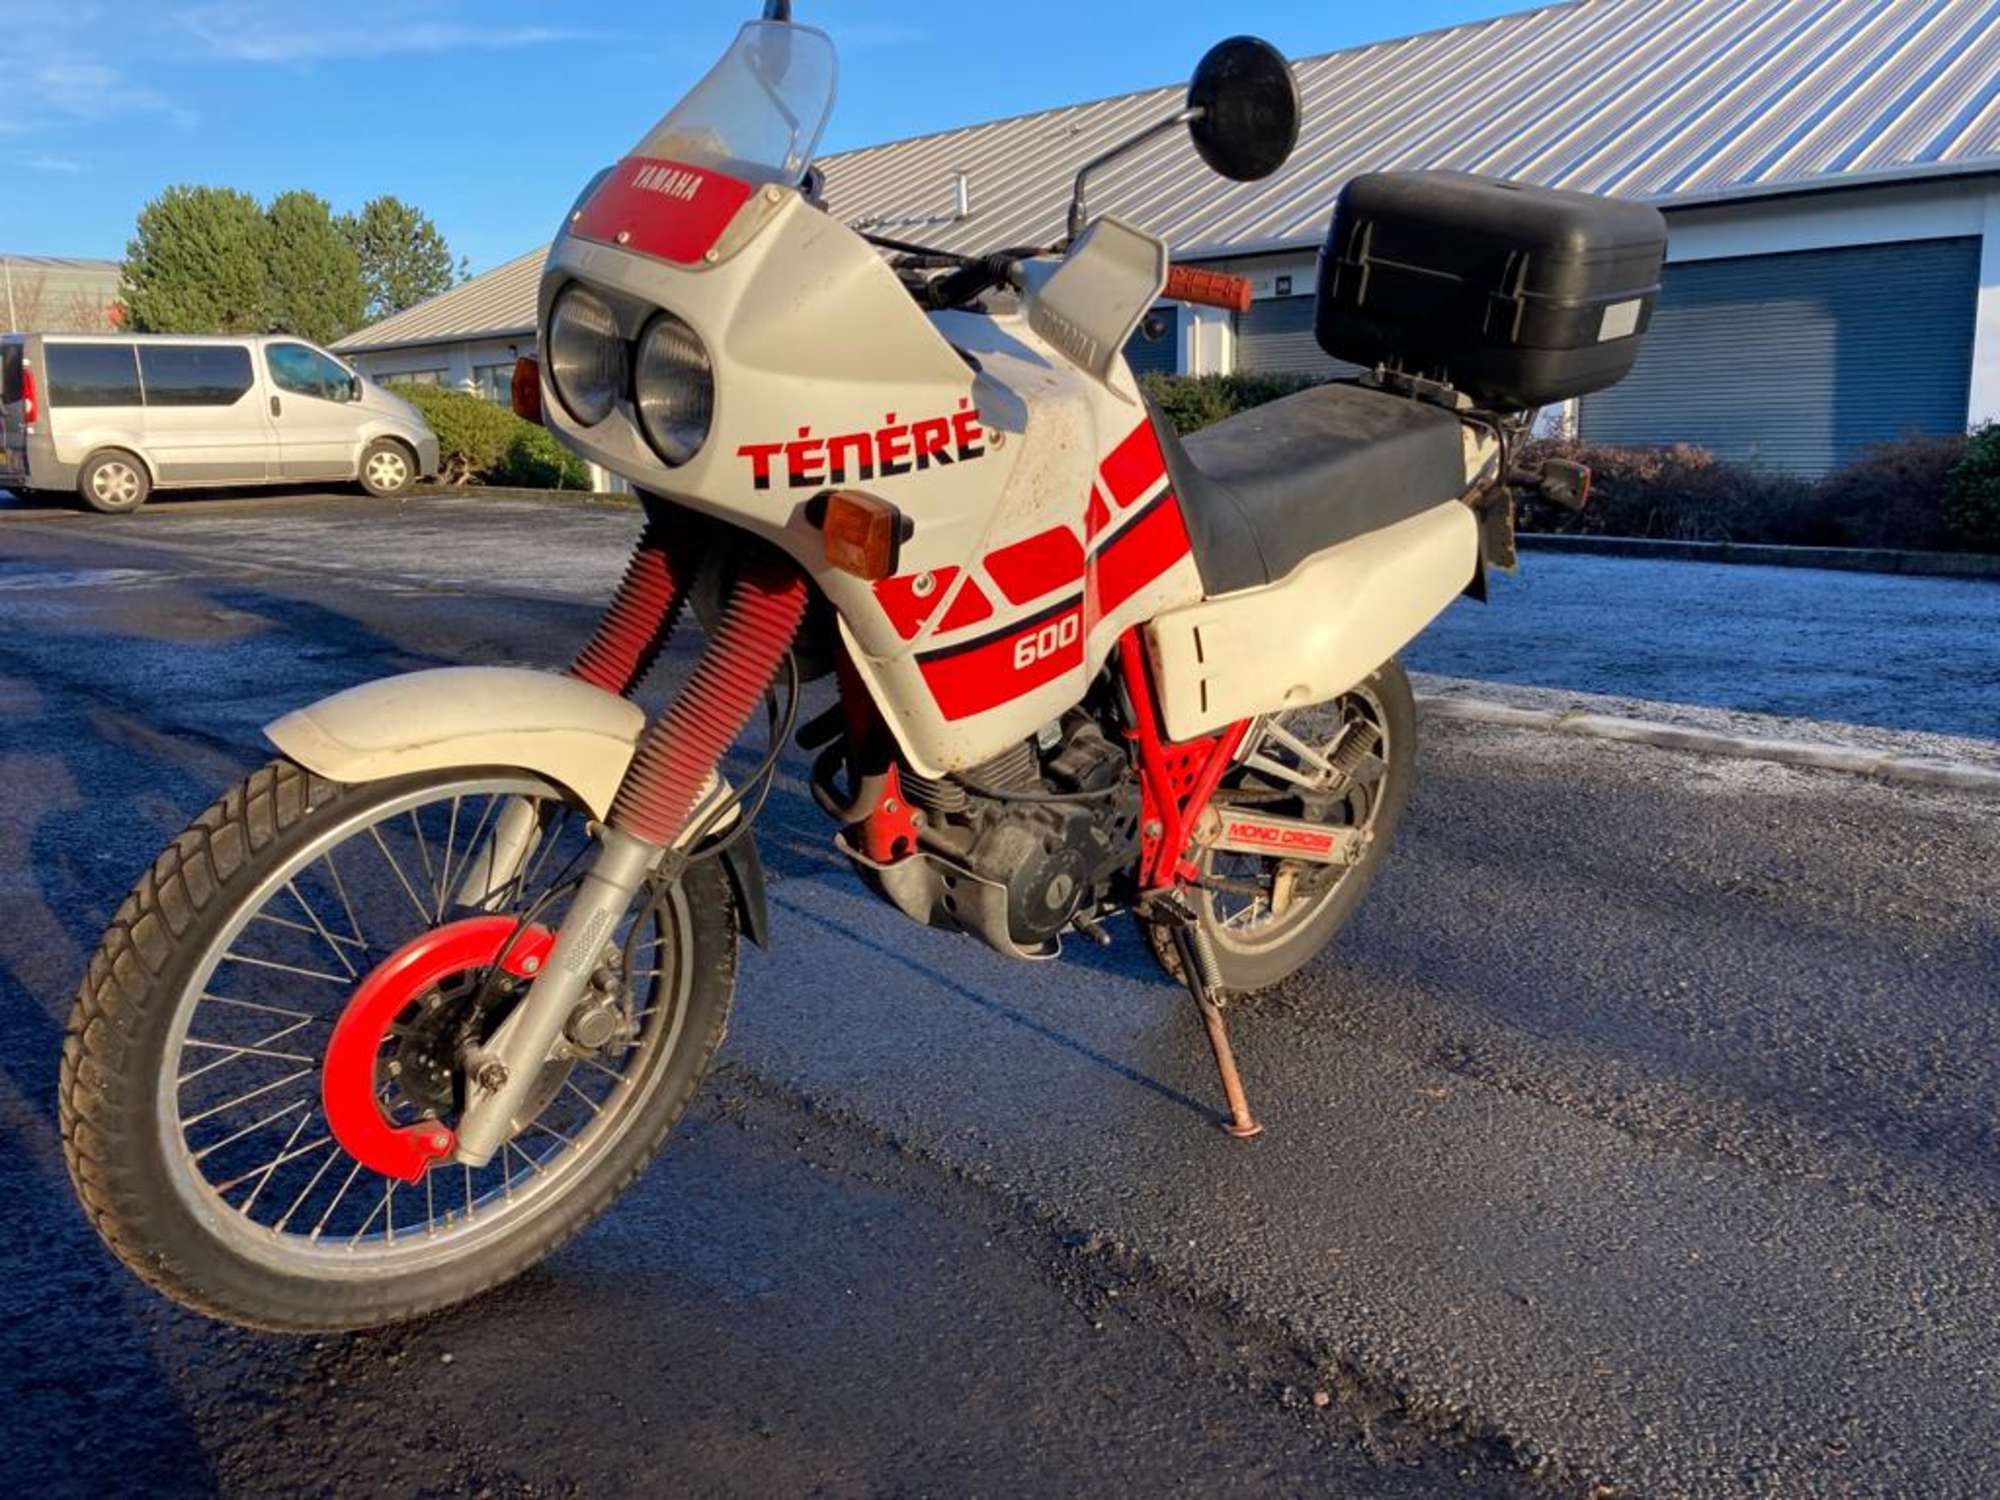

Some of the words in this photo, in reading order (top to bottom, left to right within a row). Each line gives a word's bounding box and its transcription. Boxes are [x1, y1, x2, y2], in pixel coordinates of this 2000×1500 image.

[631, 164, 704, 202] YAMAHA
[1013, 612, 1079, 671] 600
[1229, 823, 1280, 842] MONO
